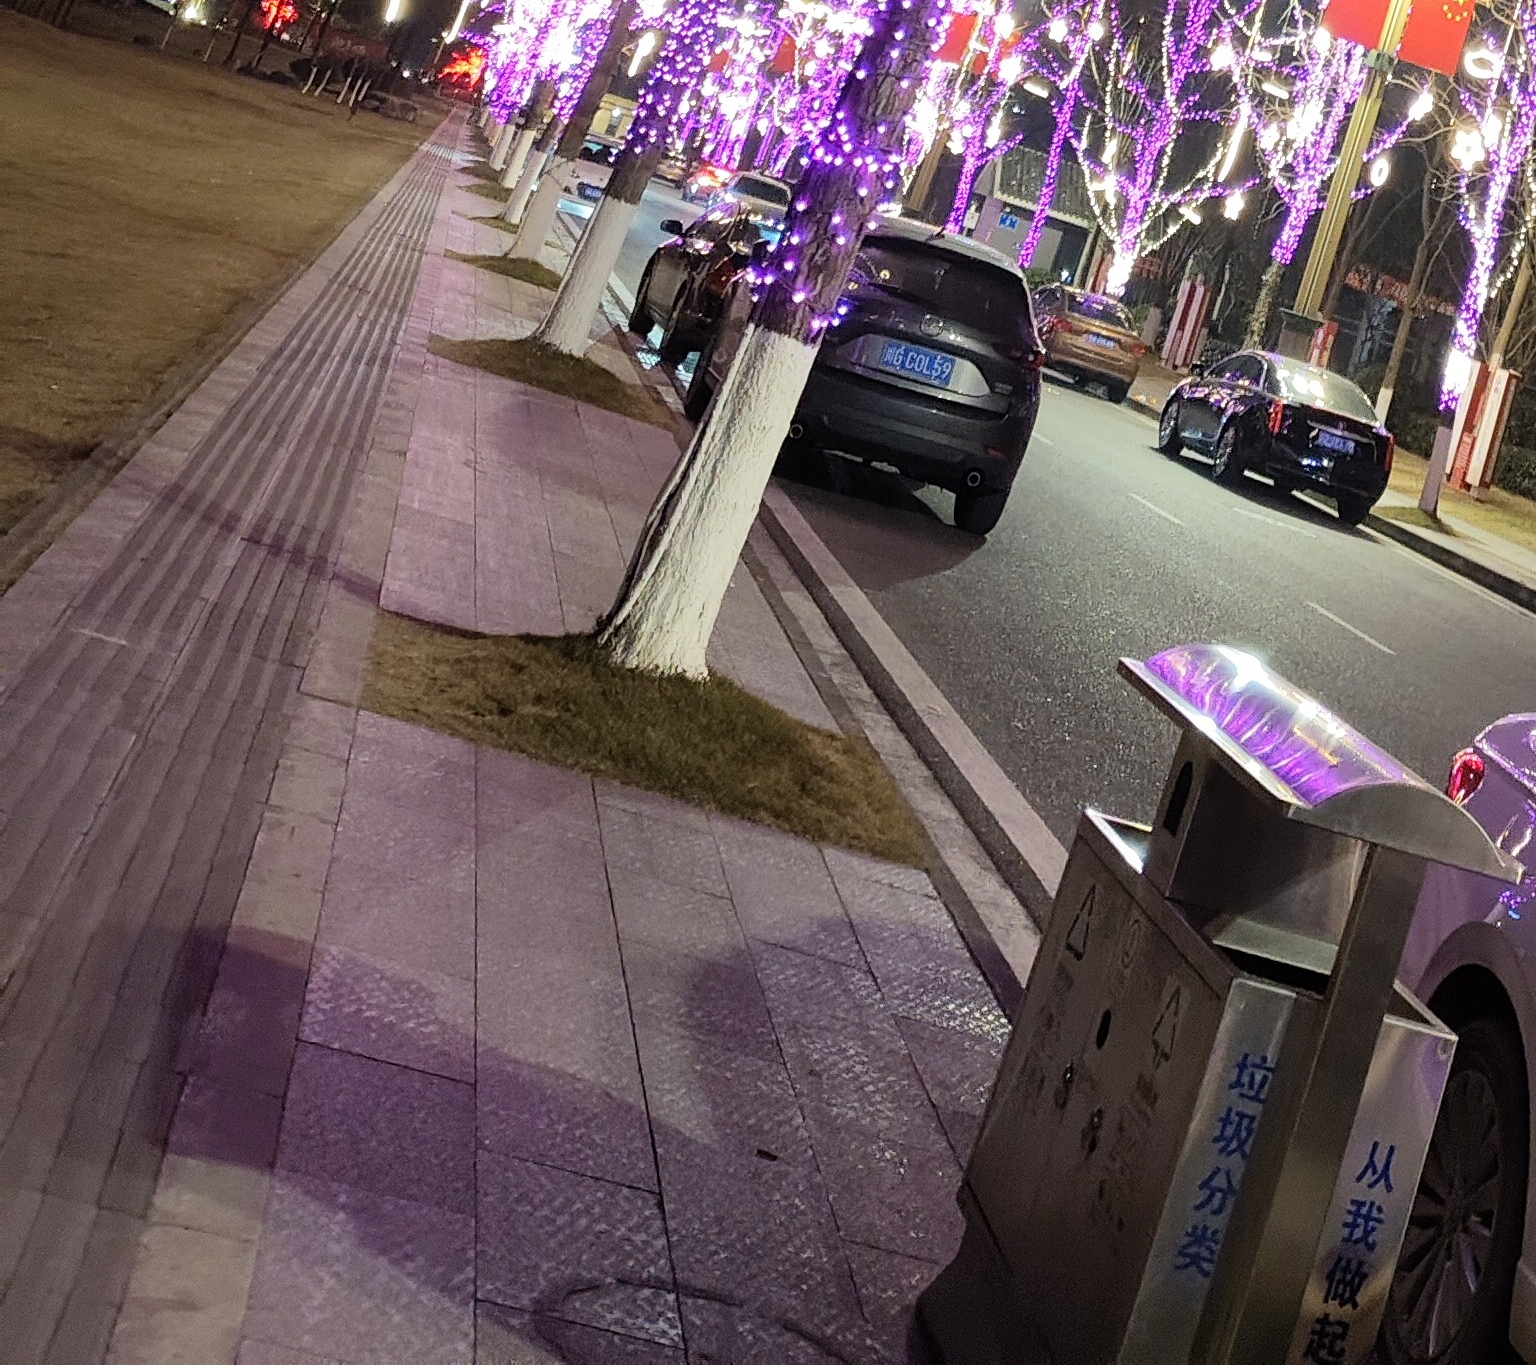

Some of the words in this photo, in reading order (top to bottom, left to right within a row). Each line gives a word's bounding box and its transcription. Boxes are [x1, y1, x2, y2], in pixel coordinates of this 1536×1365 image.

[1174, 1052, 1275, 1279] 垃圾分类
[1303, 1140, 1397, 1363] 从我做起
